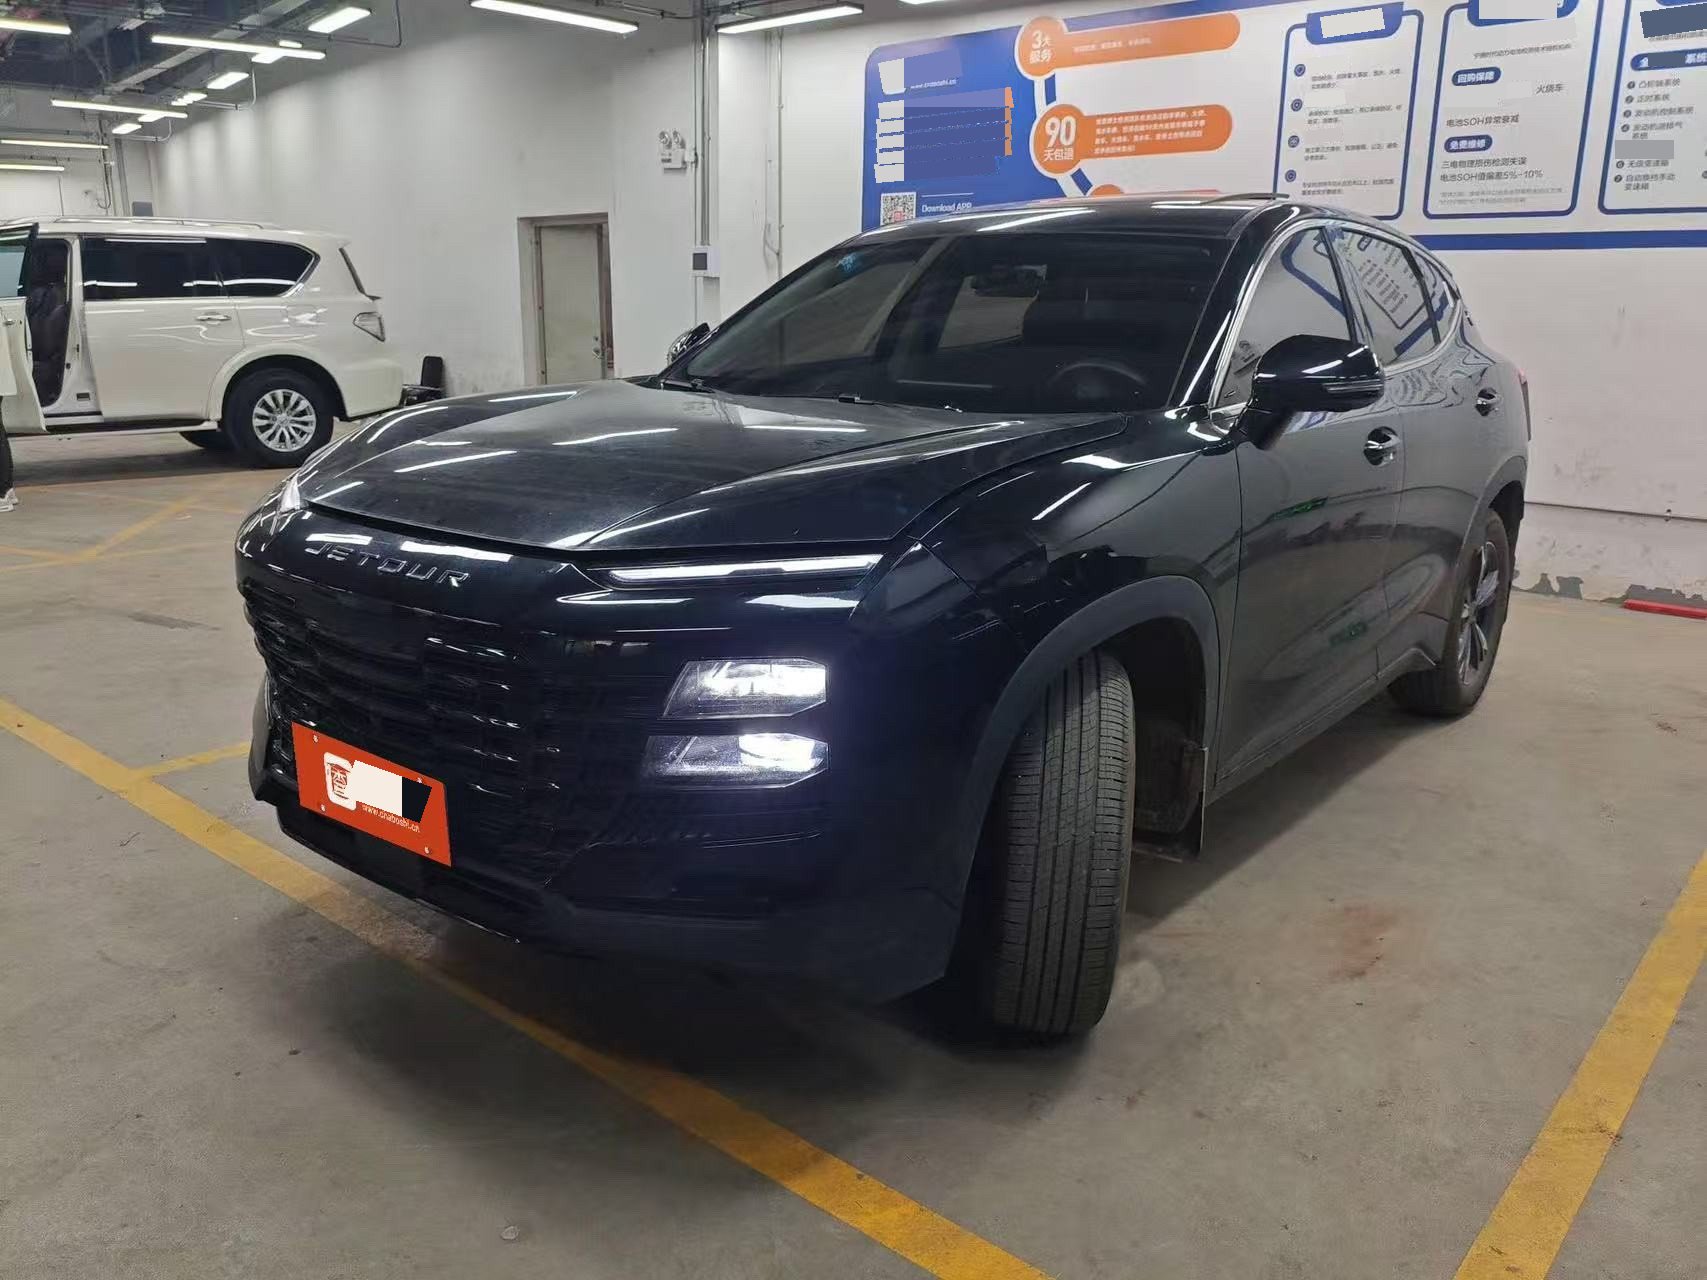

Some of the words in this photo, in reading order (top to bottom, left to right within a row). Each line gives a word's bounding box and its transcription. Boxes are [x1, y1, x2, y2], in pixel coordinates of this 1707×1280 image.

[1045, 115, 1077, 148] 90
[1044, 147, 1074, 161] 天包退
[305, 542, 470, 588] JETOUR
